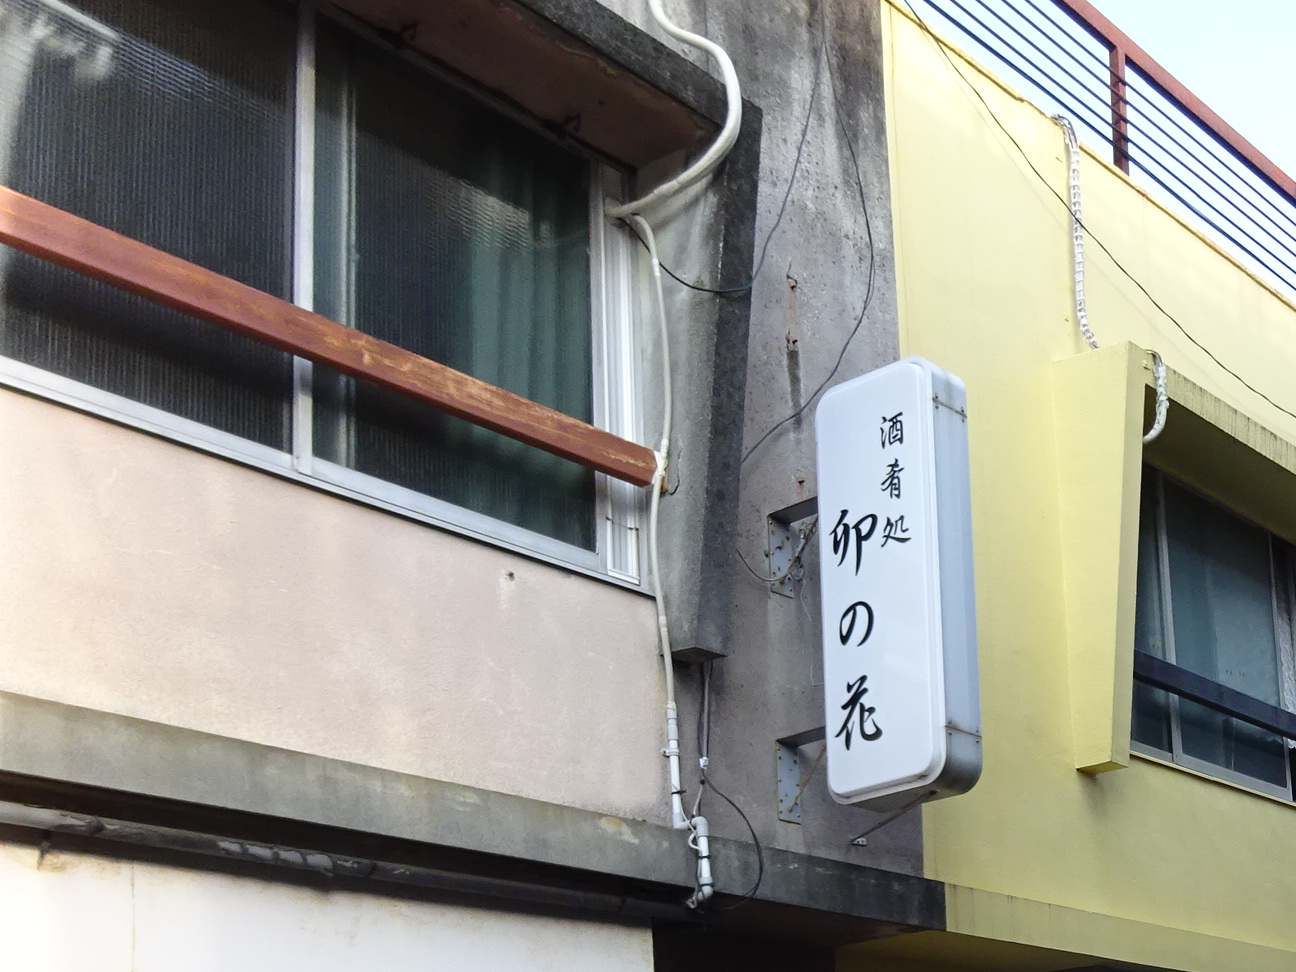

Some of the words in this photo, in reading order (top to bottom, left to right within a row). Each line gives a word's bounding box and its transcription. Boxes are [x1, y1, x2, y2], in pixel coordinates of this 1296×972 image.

[879, 411, 912, 548] 酒肴処
[829, 508, 883, 751] 卯の花
